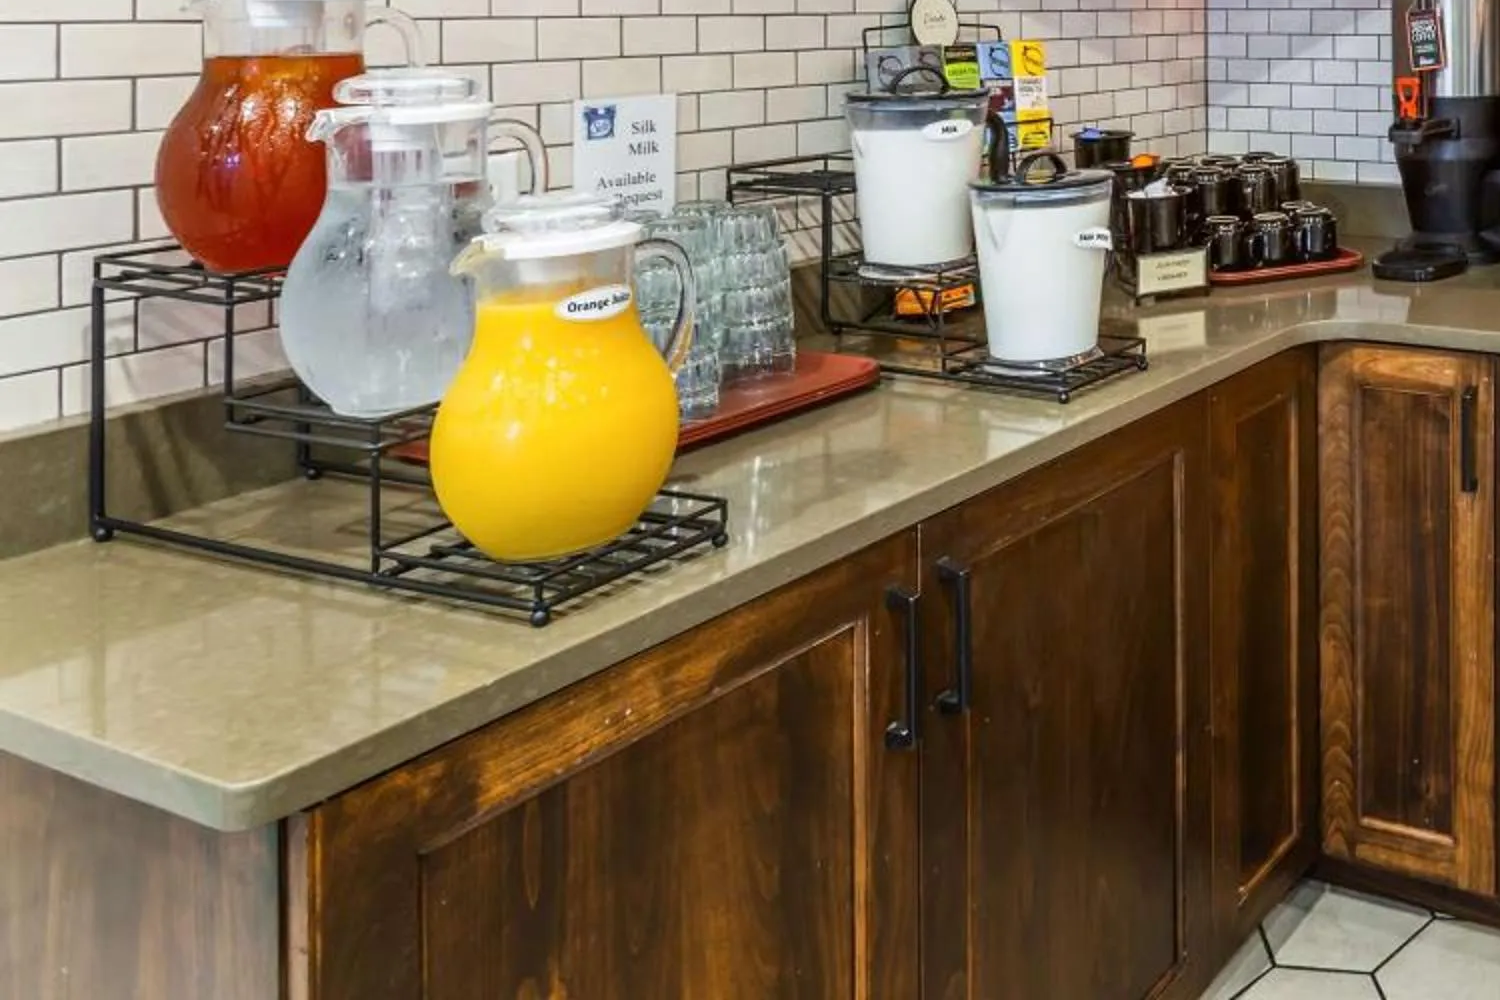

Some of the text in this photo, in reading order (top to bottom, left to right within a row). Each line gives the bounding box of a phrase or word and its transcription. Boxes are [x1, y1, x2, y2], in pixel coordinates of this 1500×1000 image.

[631, 120, 657, 135] Silk
[628, 141, 660, 156] Milk
[597, 168, 657, 190] Available
[566, 298, 610, 314] Orange
